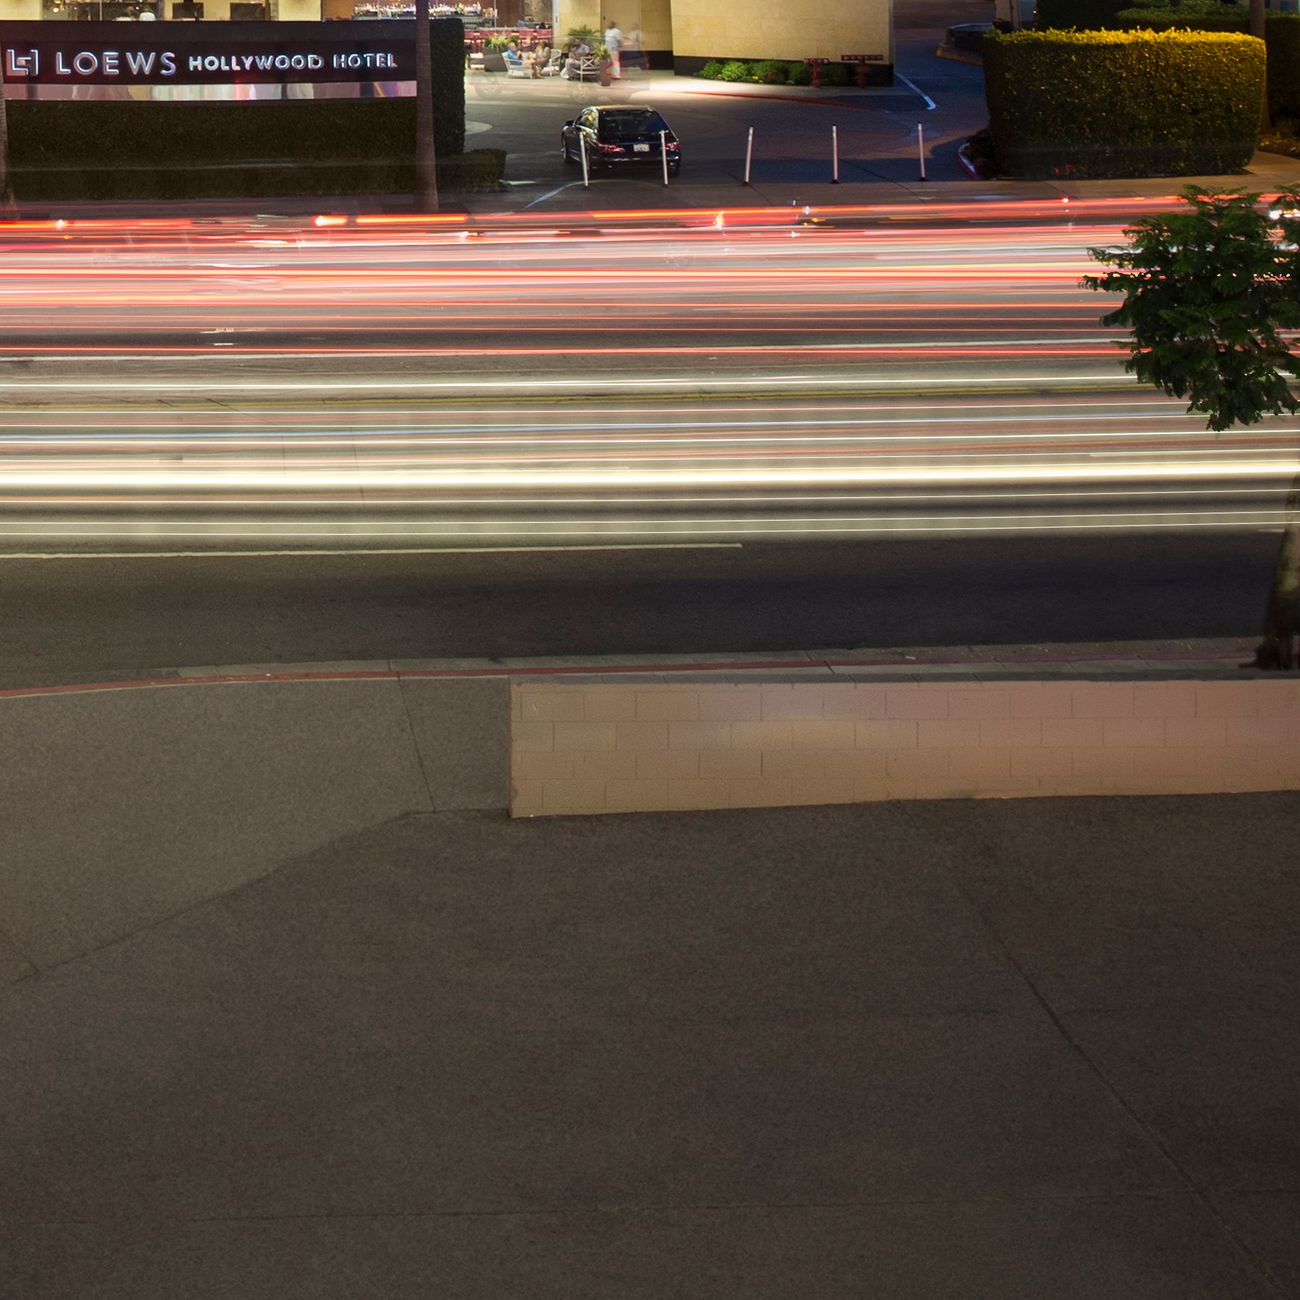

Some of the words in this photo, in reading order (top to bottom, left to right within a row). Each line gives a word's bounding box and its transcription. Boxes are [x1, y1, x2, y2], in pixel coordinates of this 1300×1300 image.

[55, 52, 177, 76] LOEWS
[188, 55, 324, 71] HOLLYWOOD
[333, 53, 398, 69] HOTEL
